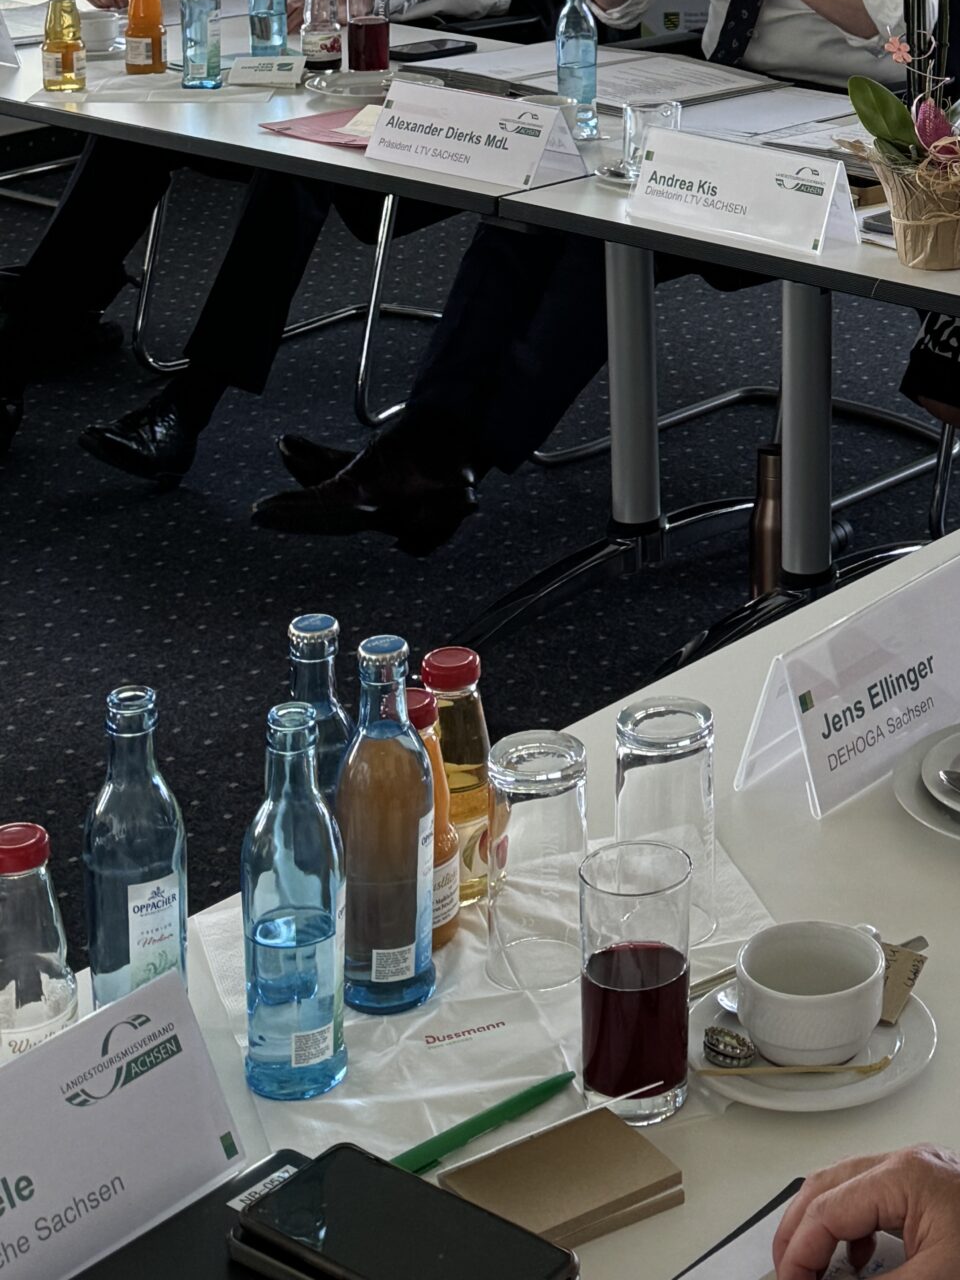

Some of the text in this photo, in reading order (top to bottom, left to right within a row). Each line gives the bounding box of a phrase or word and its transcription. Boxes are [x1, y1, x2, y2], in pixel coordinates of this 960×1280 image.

[385, 115, 509, 151] Alexander Dierks MdL
[378, 137, 471, 164] Präsident LTV SACHSEN
[648, 170, 719, 197] Andrea Kis
[645, 185, 748, 216] Direktorin LTV SACHSEN
[821, 654, 935, 740] Jens Ellinger
[827, 695, 935, 772] DEHOGA Sachsen
[132, 892, 177, 914] OPPACHER
[424, 1020, 506, 1045] Dussmann
[60, 1022, 175, 1095] LANDESTOURISMUSVERBAND
[34, 1175, 126, 1242] Sachsen
